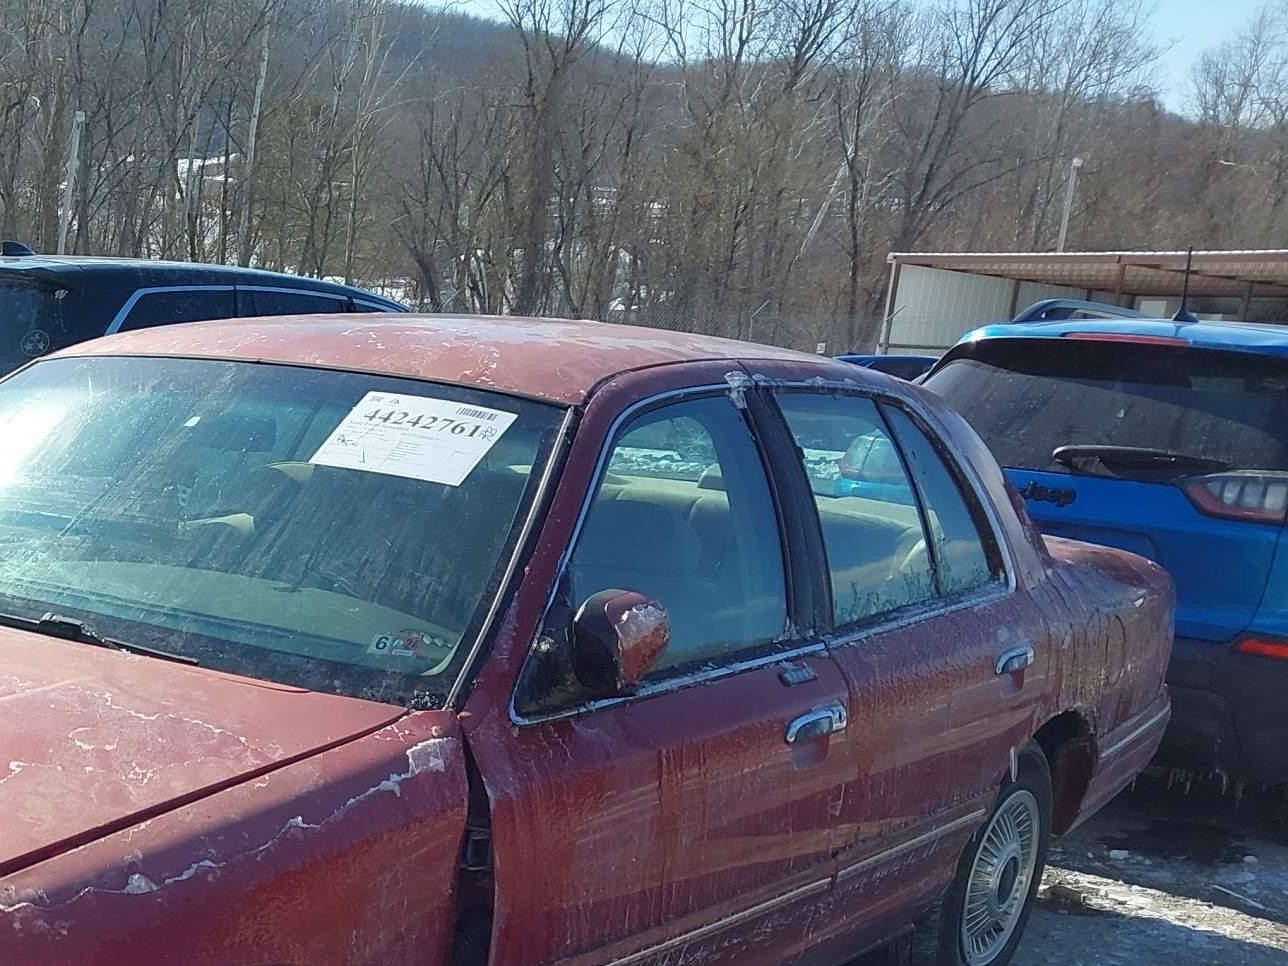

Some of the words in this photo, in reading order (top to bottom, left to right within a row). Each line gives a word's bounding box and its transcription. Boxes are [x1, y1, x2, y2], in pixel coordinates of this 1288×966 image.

[363, 408, 482, 438] 44242761
[1019, 480, 1078, 508] Jeep
[375, 636, 389, 650] 6
